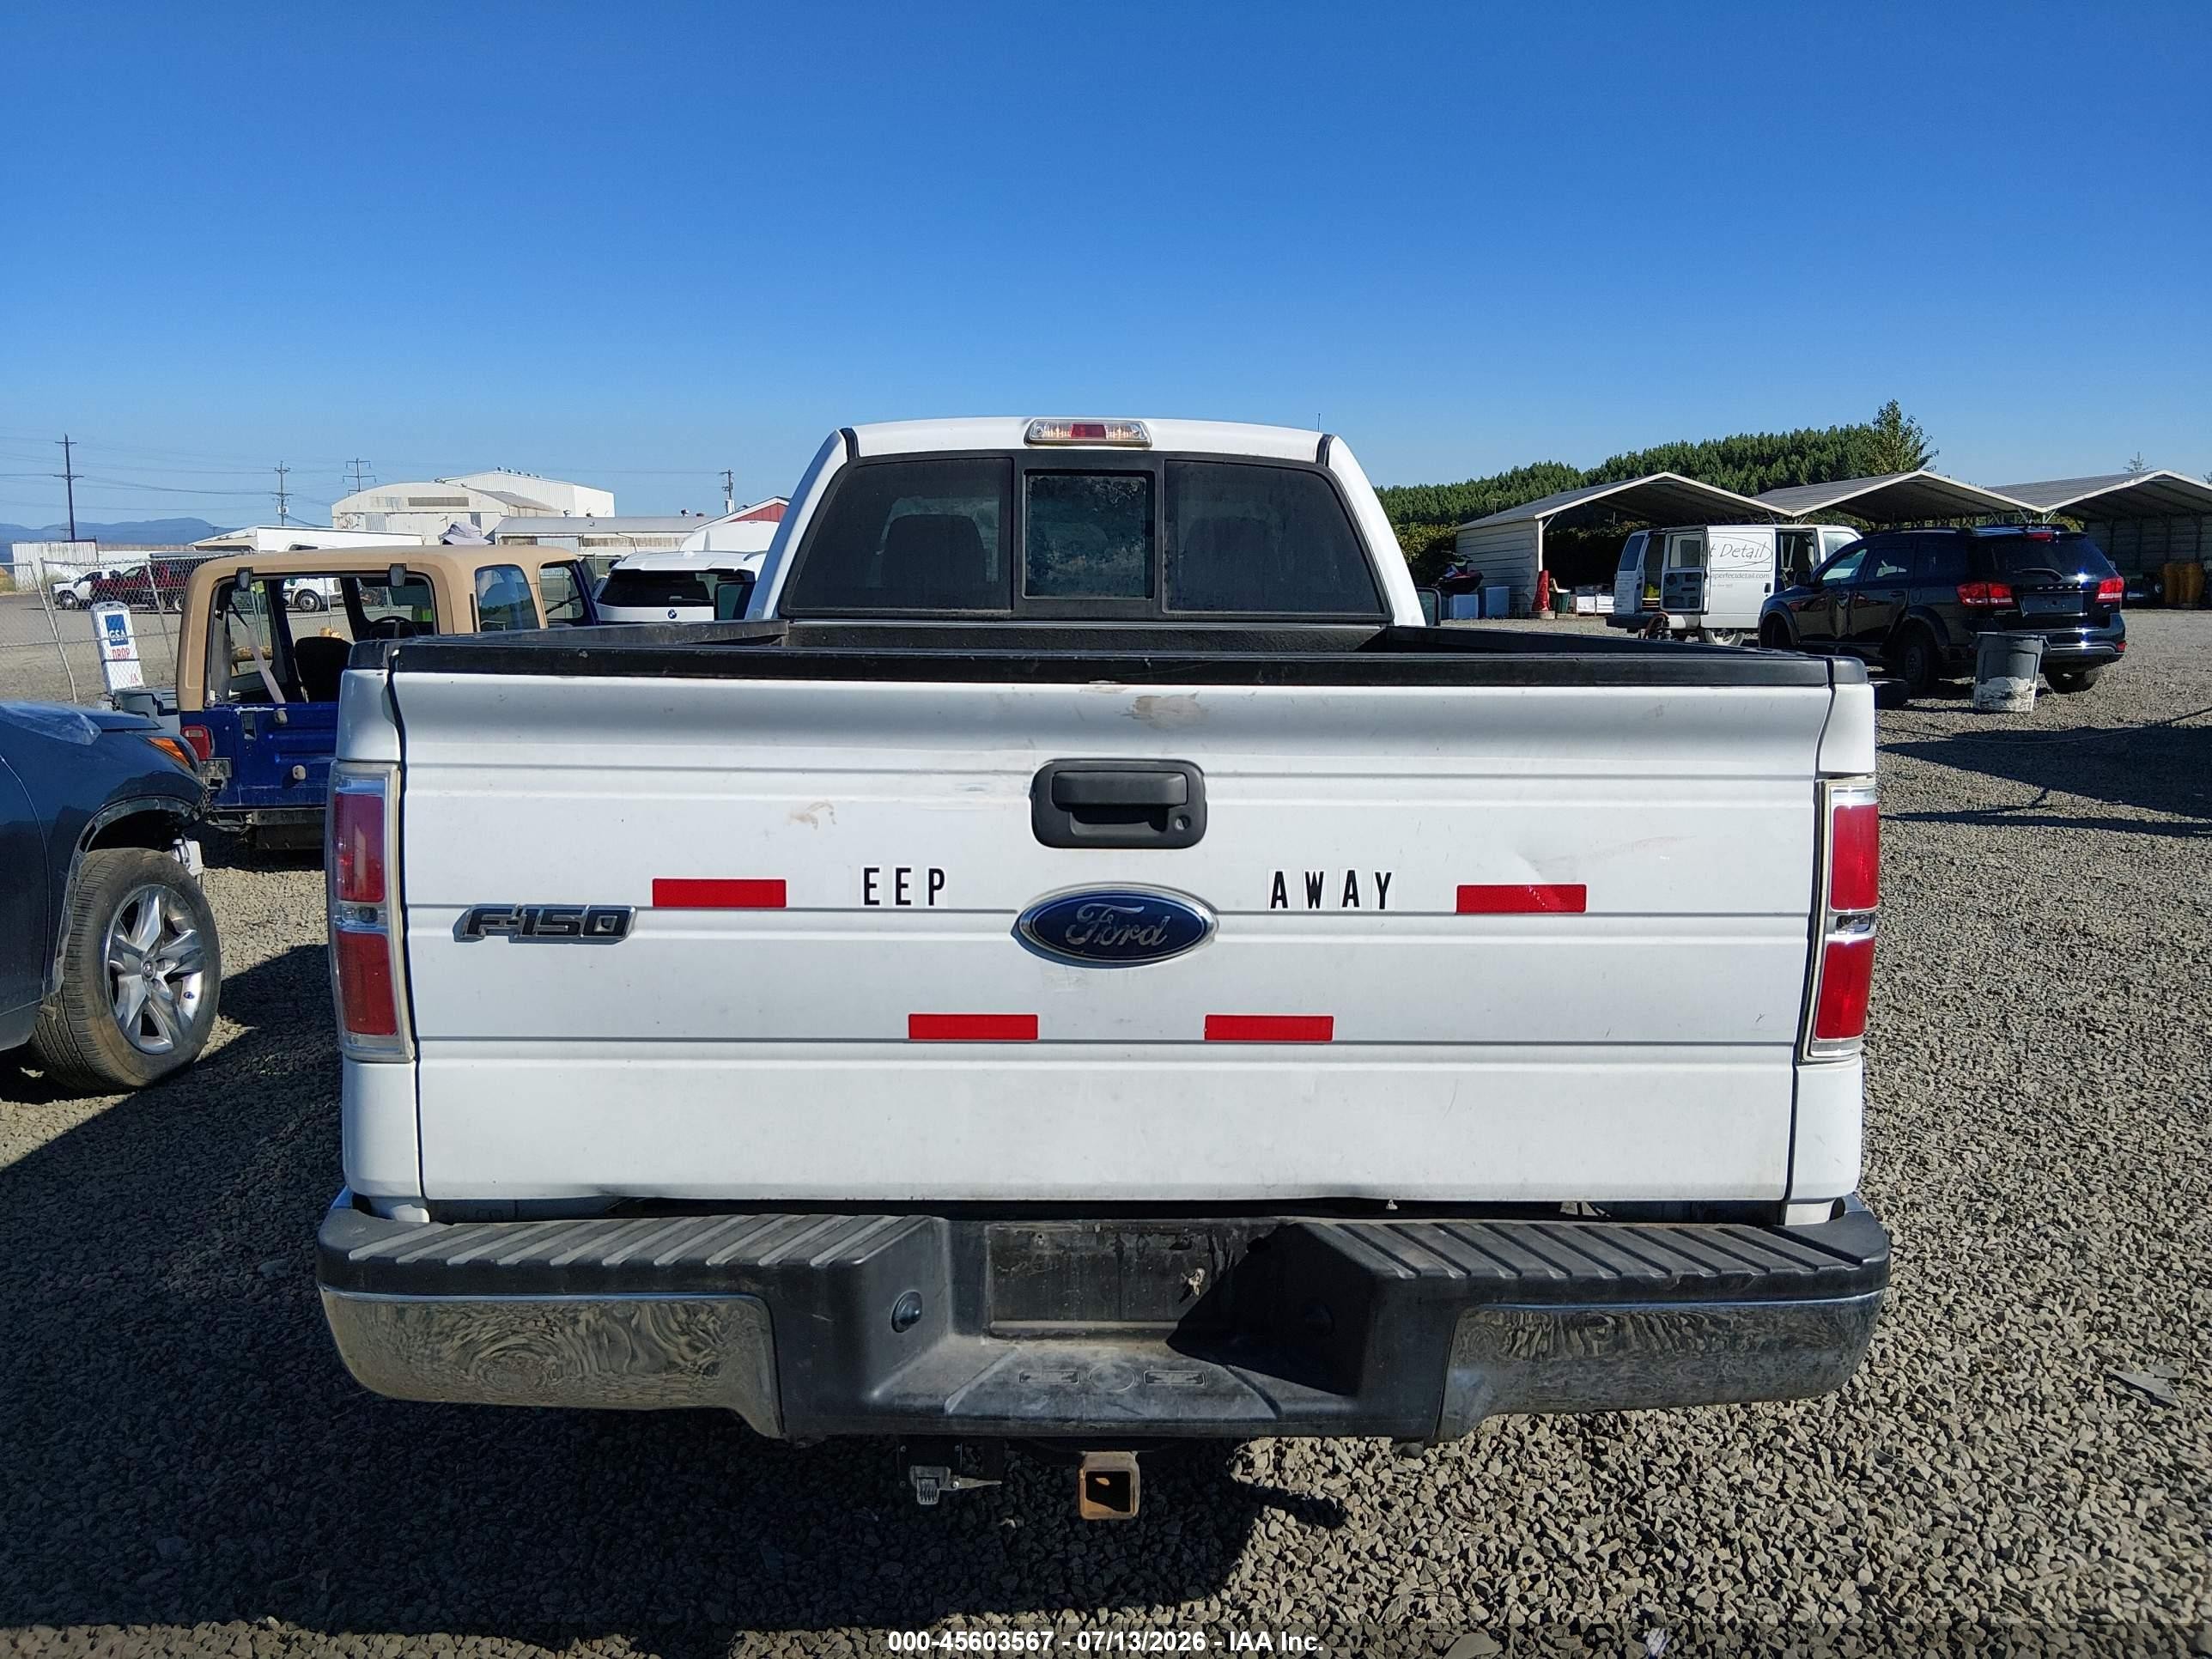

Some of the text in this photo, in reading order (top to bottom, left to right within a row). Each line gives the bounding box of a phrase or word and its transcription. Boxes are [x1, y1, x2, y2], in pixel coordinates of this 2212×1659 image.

[1720, 542, 1767, 559] Detail
[109, 629, 128, 642] GSA
[112, 647, 131, 660] DROP
[864, 867, 1392, 909] EEP AWAY
[464, 904, 636, 940] F-150
[1066, 902, 1170, 945] Ford
